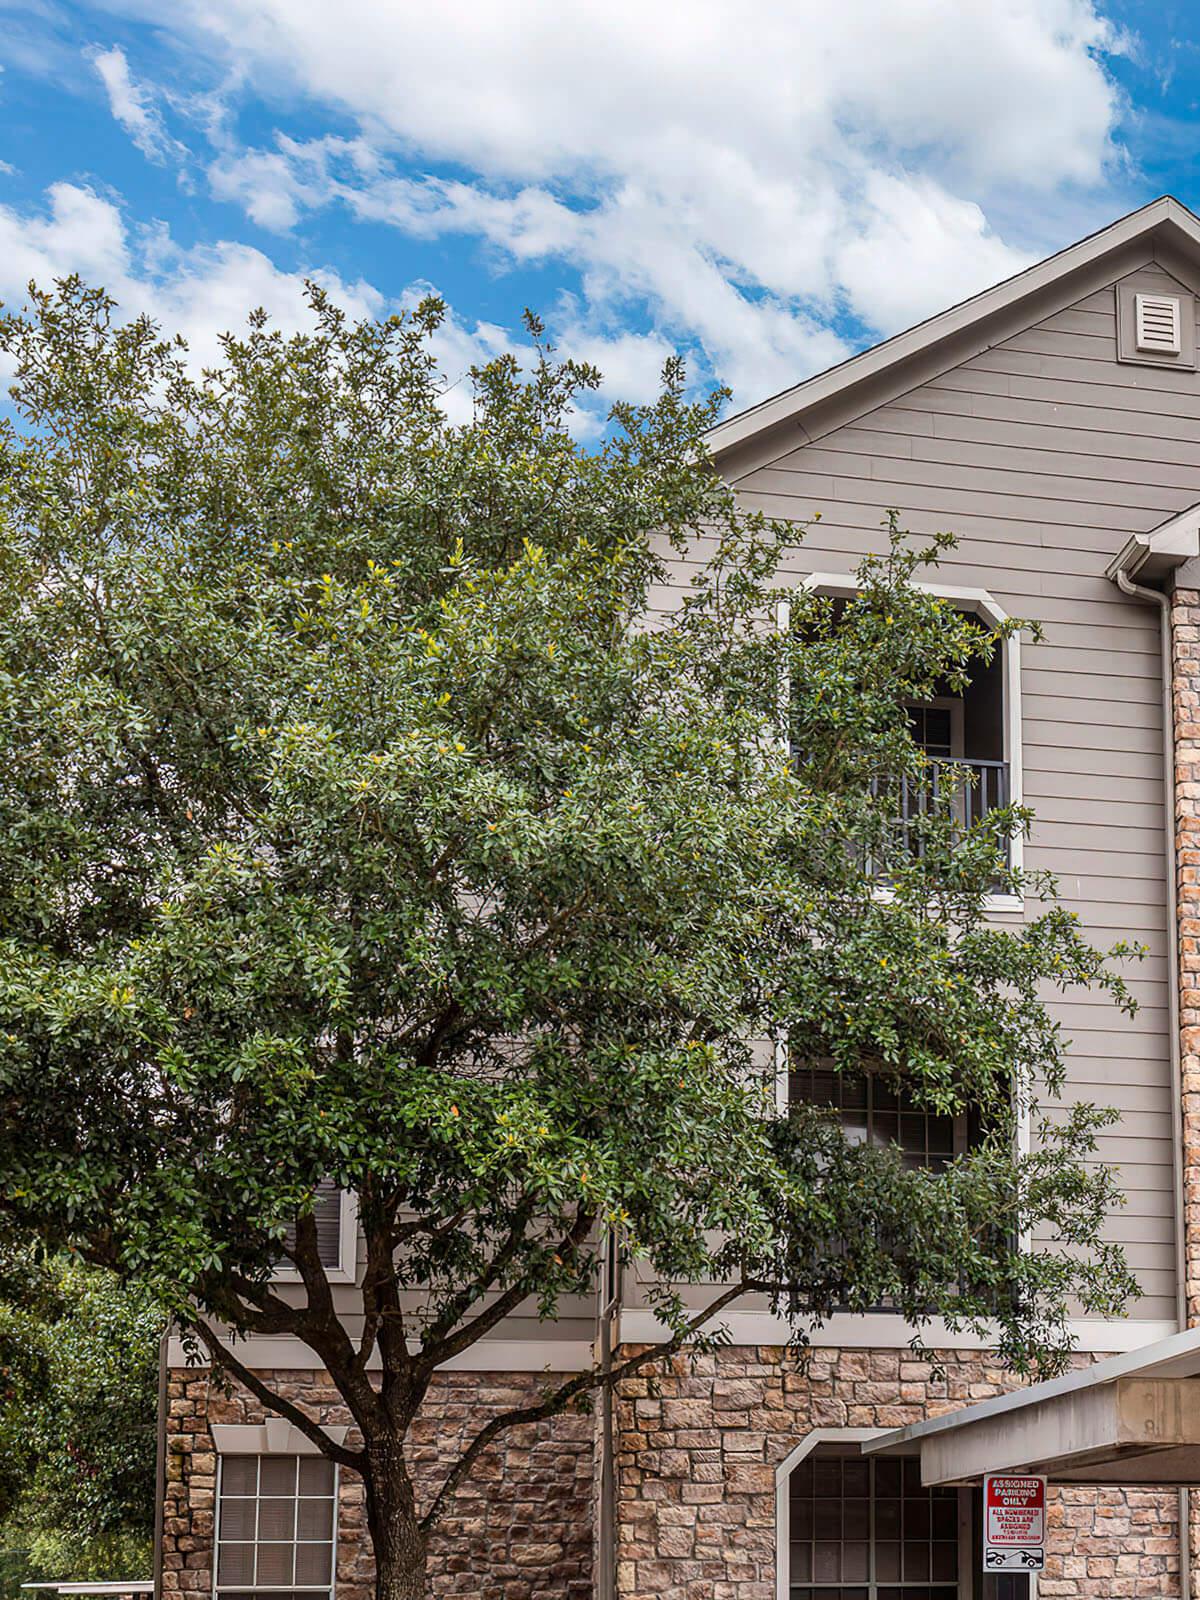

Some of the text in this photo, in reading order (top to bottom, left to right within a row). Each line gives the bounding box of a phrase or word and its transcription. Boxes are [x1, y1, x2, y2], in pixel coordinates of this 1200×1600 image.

[992, 1480, 1039, 1488] ASSIGNED
[994, 1488, 1036, 1497] PARKING
[1002, 1497, 1028, 1505] ONLY
